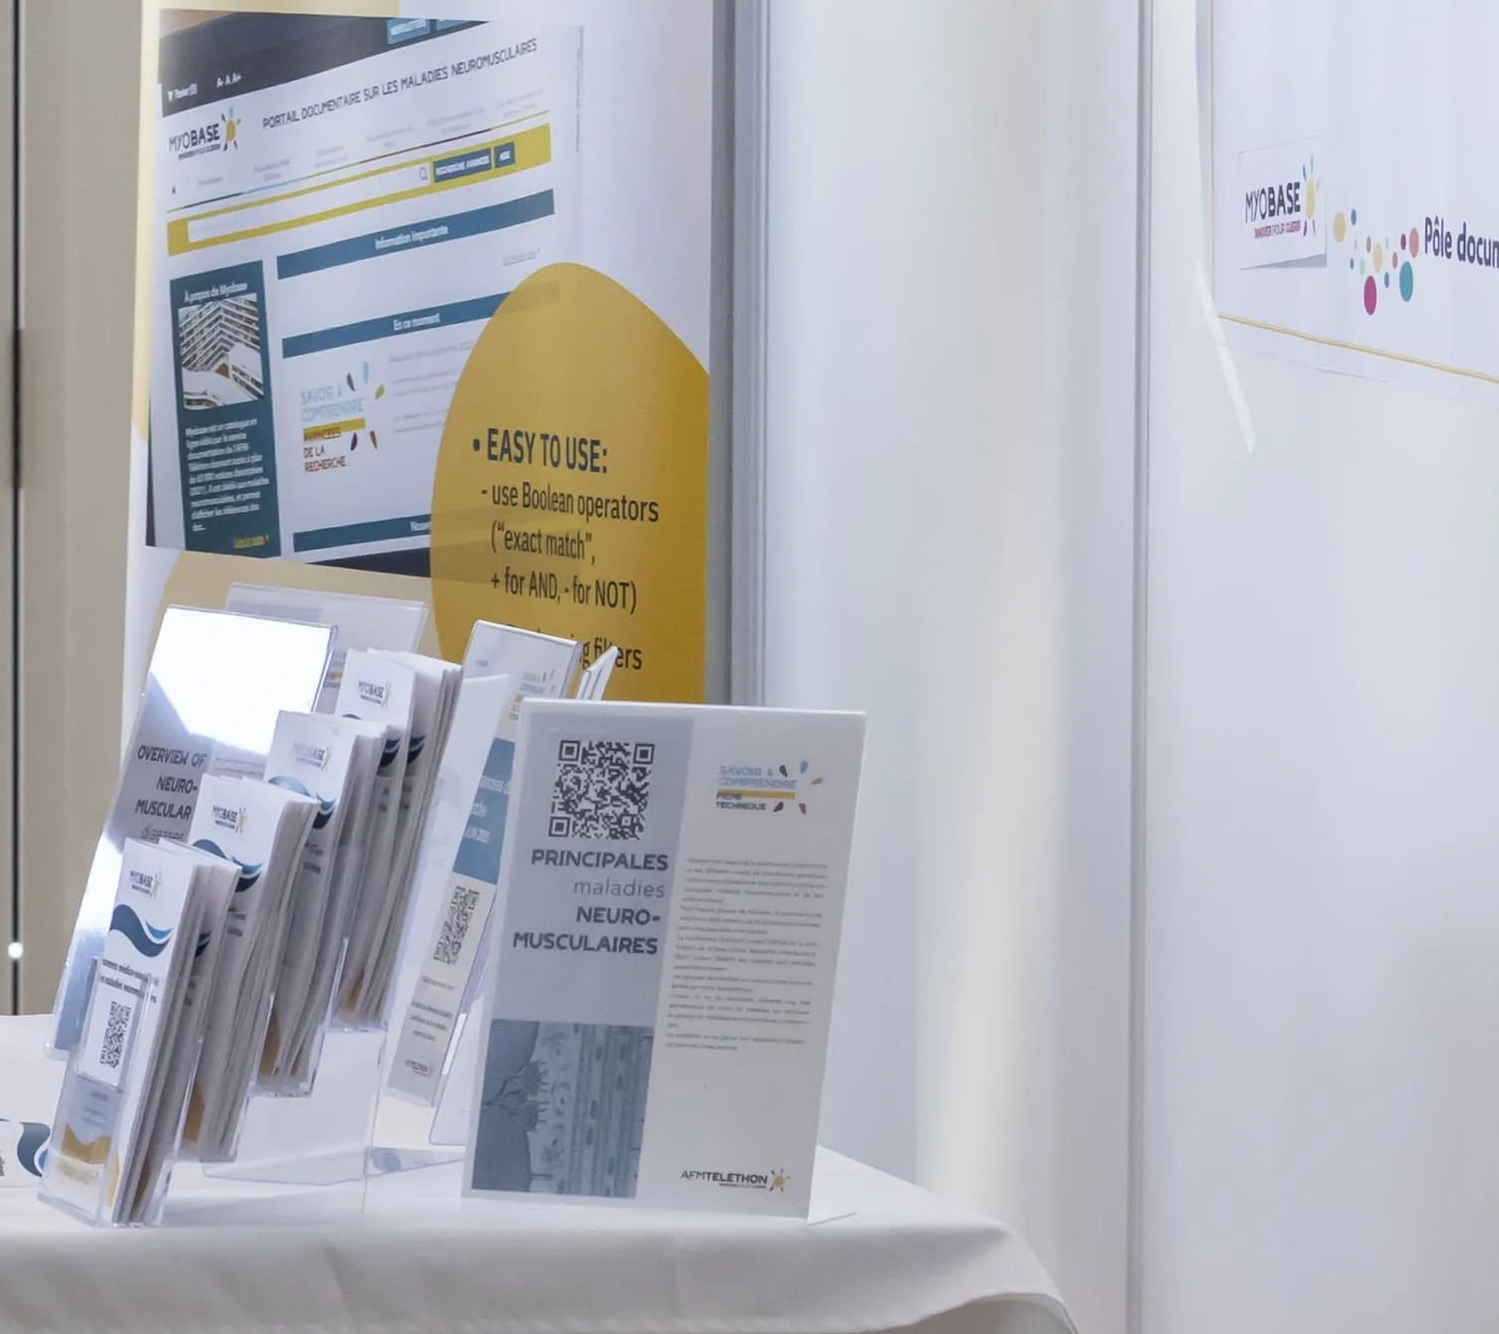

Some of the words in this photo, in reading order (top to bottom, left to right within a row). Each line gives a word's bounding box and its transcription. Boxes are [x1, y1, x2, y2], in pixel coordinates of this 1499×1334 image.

[262, 110, 300, 130] PORTAIL
[301, 90, 362, 120] DOCUMENTAIRE
[363, 86, 380, 102] SUR
[382, 81, 399, 96] LES
[401, 66, 448, 90] MALADIES
[452, 38, 538, 77] NEUROMUSCULAIRES
[169, 123, 220, 152] MYOBASE
[1245, 182, 1301, 223] MYOBASE
[1424, 215, 1453, 259] Pôle
[487, 427, 536, 465] EASY
[540, 433, 562, 468] TO
[566, 437, 608, 474] USE:
[492, 484, 518, 507] use
[522, 481, 574, 515] Boolean
[577, 494, 659, 523] operators
[504, 566, 525, 596] for
[528, 571, 562, 606] AND,
[572, 575, 591, 605] for
[594, 579, 638, 616] NOT)
[594, 637, 643, 670] filers
[137, 745, 190, 766] OVERVIEW
[191, 752, 208, 767] OF
[156, 775, 199, 794] NEURO-
[135, 799, 192, 821] MUSCULAR
[716, 801, 767, 812] TECHNIQUE
[531, 849, 669, 872] PRINCIPALES
[573, 876, 666, 899] maladies
[576, 906, 661, 926] NEURO-
[513, 932, 659, 955] MUSCULAIRES
